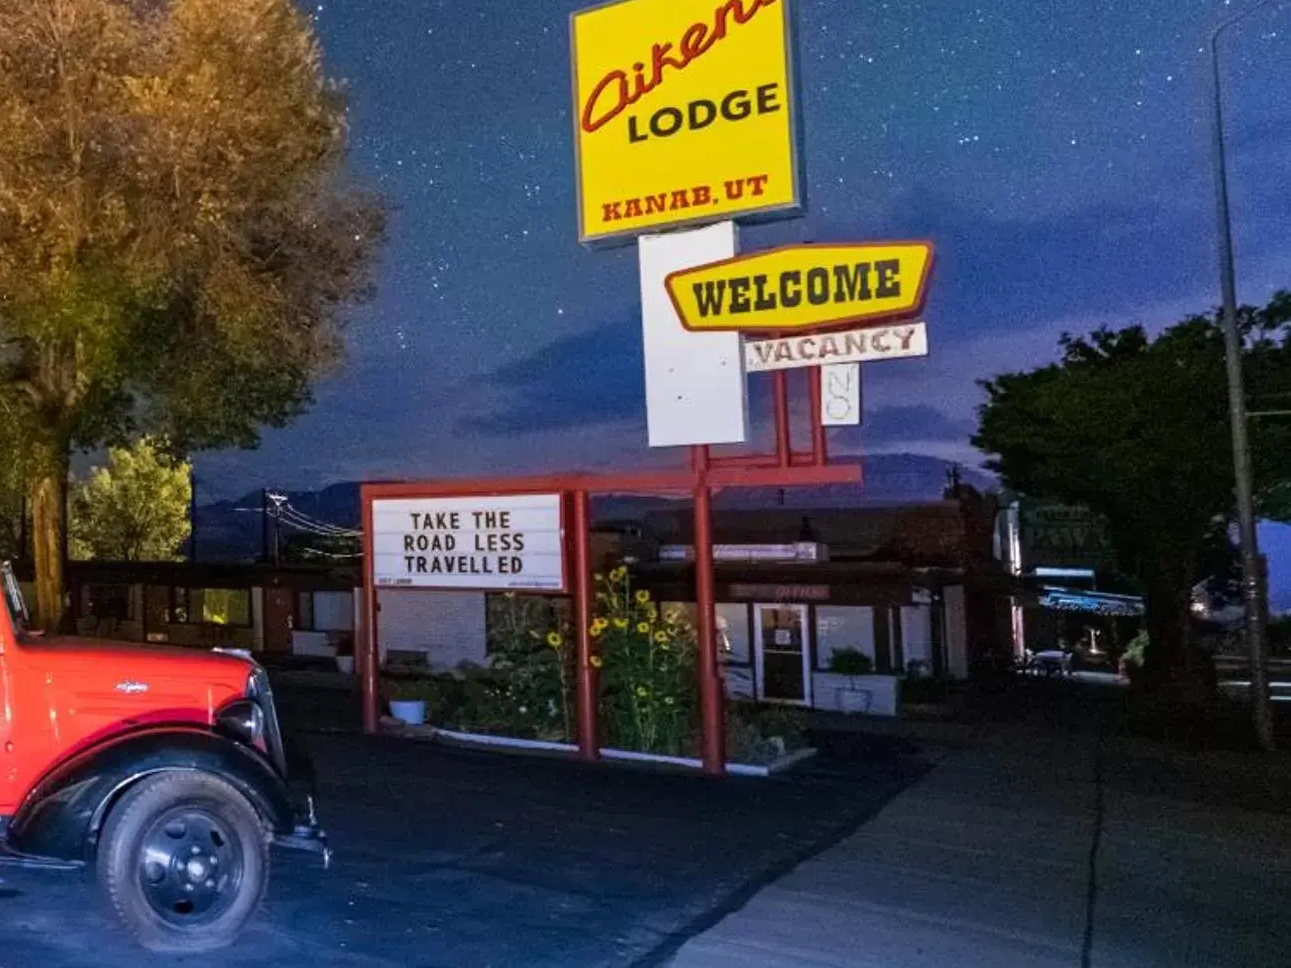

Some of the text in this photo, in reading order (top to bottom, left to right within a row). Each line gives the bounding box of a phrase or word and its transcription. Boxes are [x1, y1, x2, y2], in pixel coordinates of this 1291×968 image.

[628, 83, 780, 143] LODGE
[724, 175, 768, 201] UT
[692, 259, 900, 318] WELCOME
[752, 328, 916, 364] VACANCY
[410, 511, 510, 530] TAKE THE
[404, 533, 525, 551] ROAD LESS
[404, 555, 523, 574] TRAVELLED
